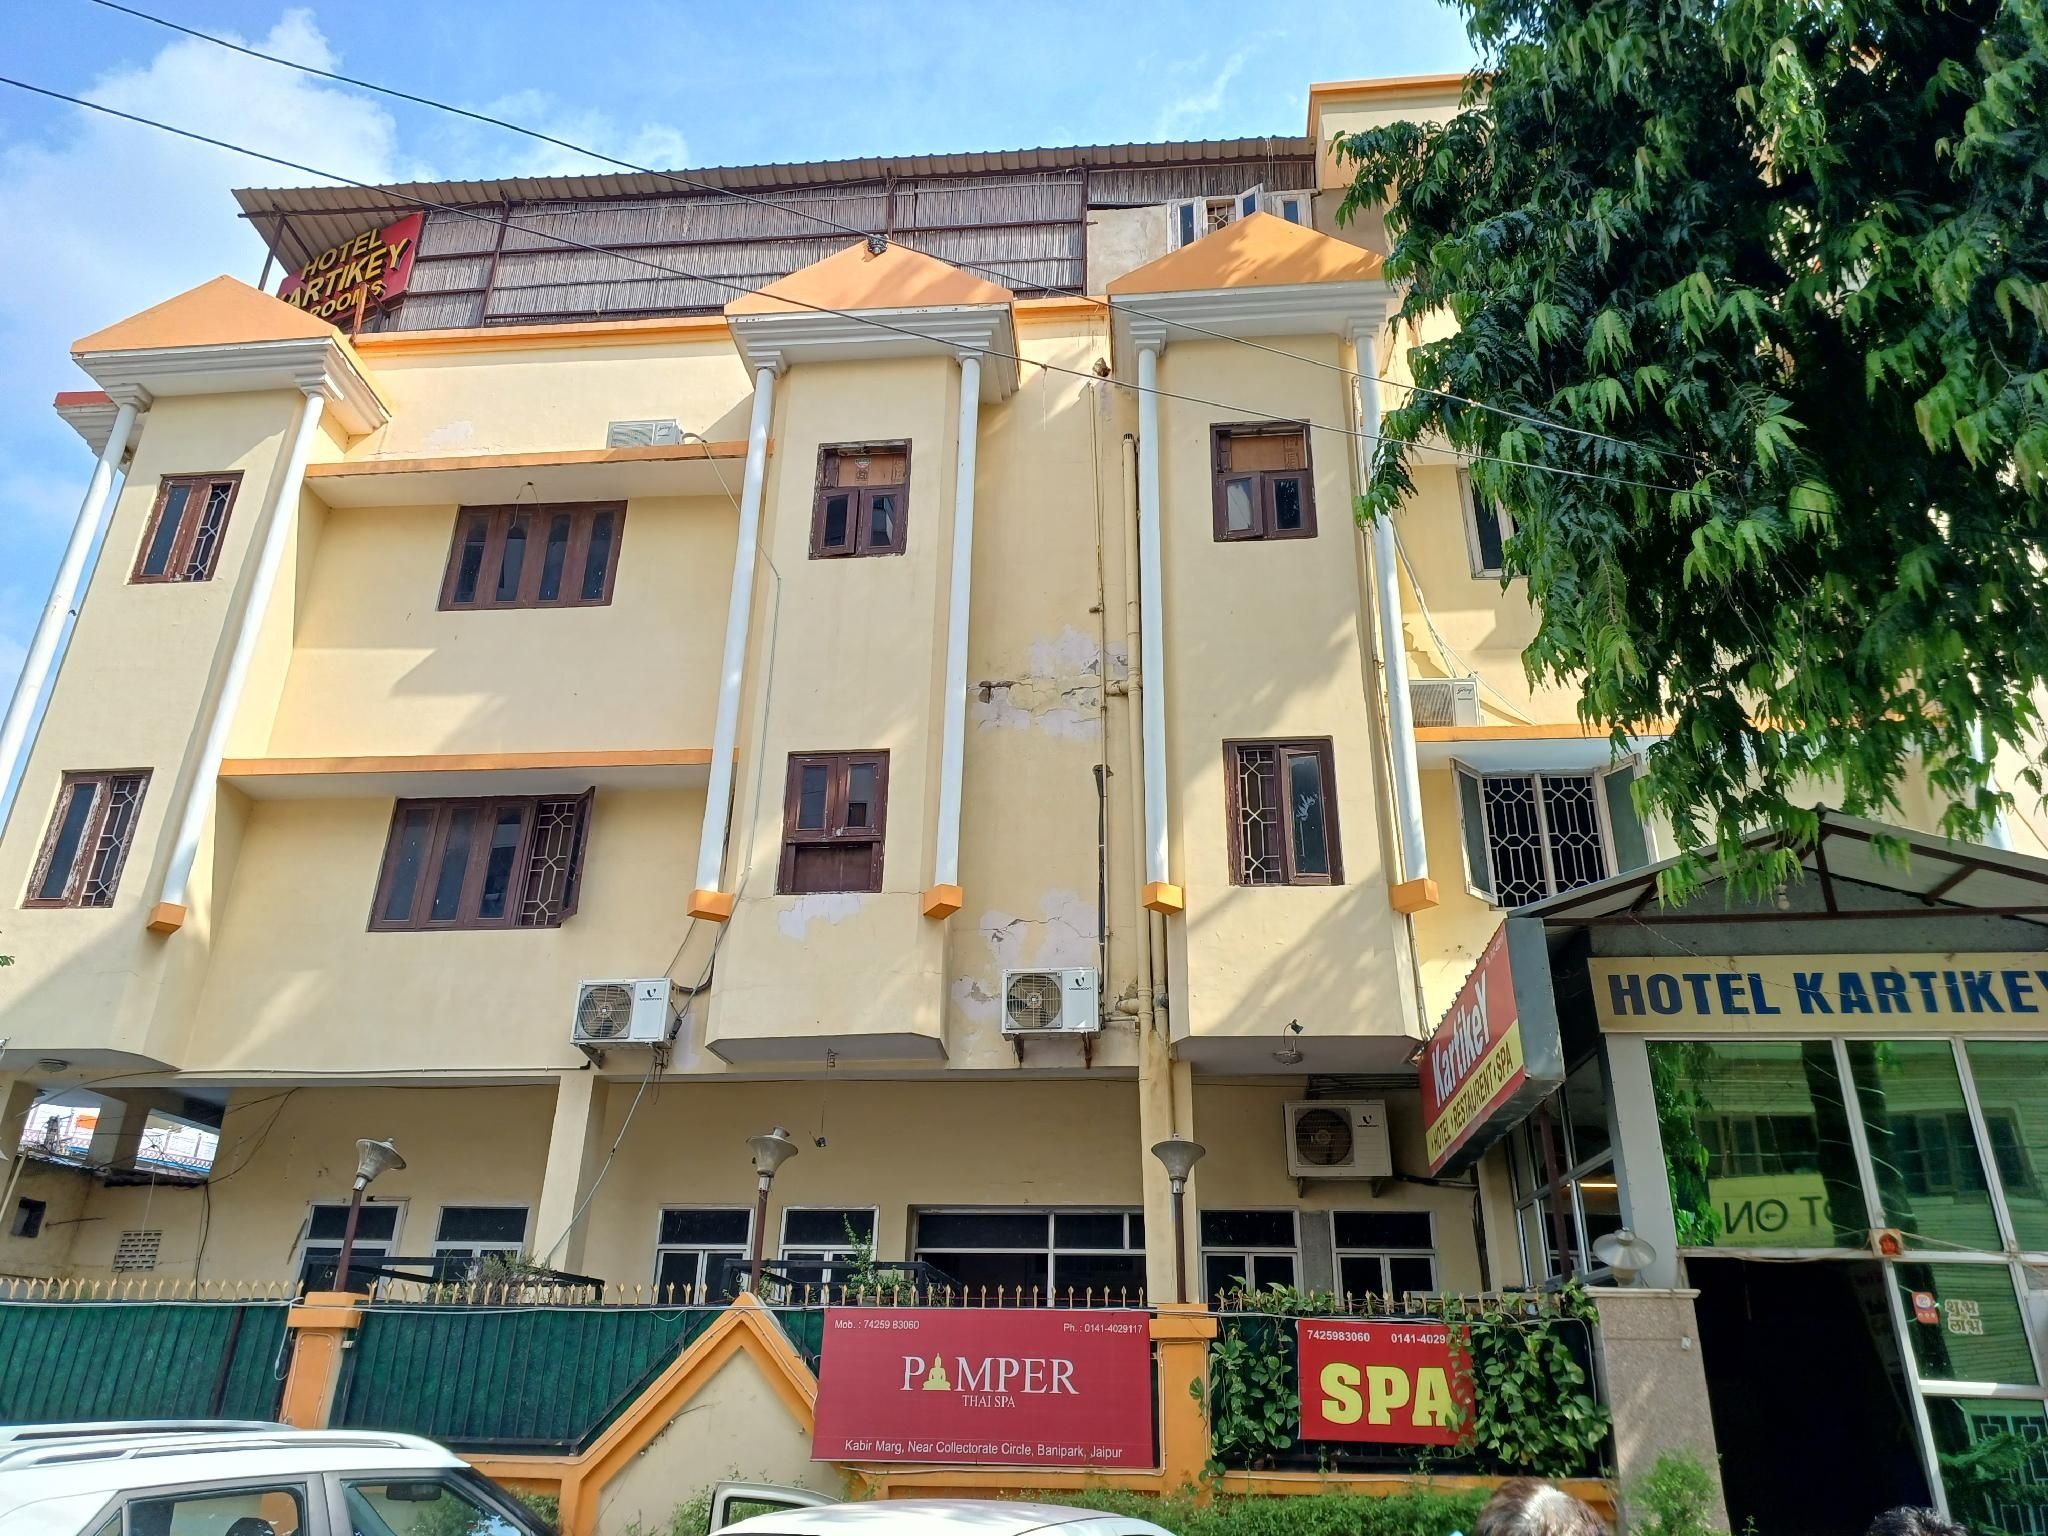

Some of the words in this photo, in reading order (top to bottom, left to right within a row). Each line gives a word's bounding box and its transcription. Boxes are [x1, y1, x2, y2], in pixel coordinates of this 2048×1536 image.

[301, 228, 384, 281] HOTEL
[279, 238, 410, 308] ARTIKEY
[1607, 973, 1782, 1016] HOTEL
[1496, 1041, 1514, 1083] SPA
[864, 1319, 891, 1329] 74259
[1084, 1323, 1143, 1334] 0141-4029117
[1307, 1329, 1370, 1342] 7425983060
[1391, 1333, 1447, 1345] 0141-4029
[962, 1395, 991, 1408] THAI
[994, 1396, 1016, 1409] SPA
[1320, 1363, 1458, 1427] SPA
[845, 1439, 872, 1451] Kabir
[875, 1440, 905, 1455] Marg,
[908, 1441, 934, 1453] Near
[936, 1441, 998, 1454] Collectorate
[1001, 1443, 1034, 1457] Circle,
[1037, 1444, 1088, 1461] Banipark,
[1090, 1446, 1123, 1460] Jaipur
